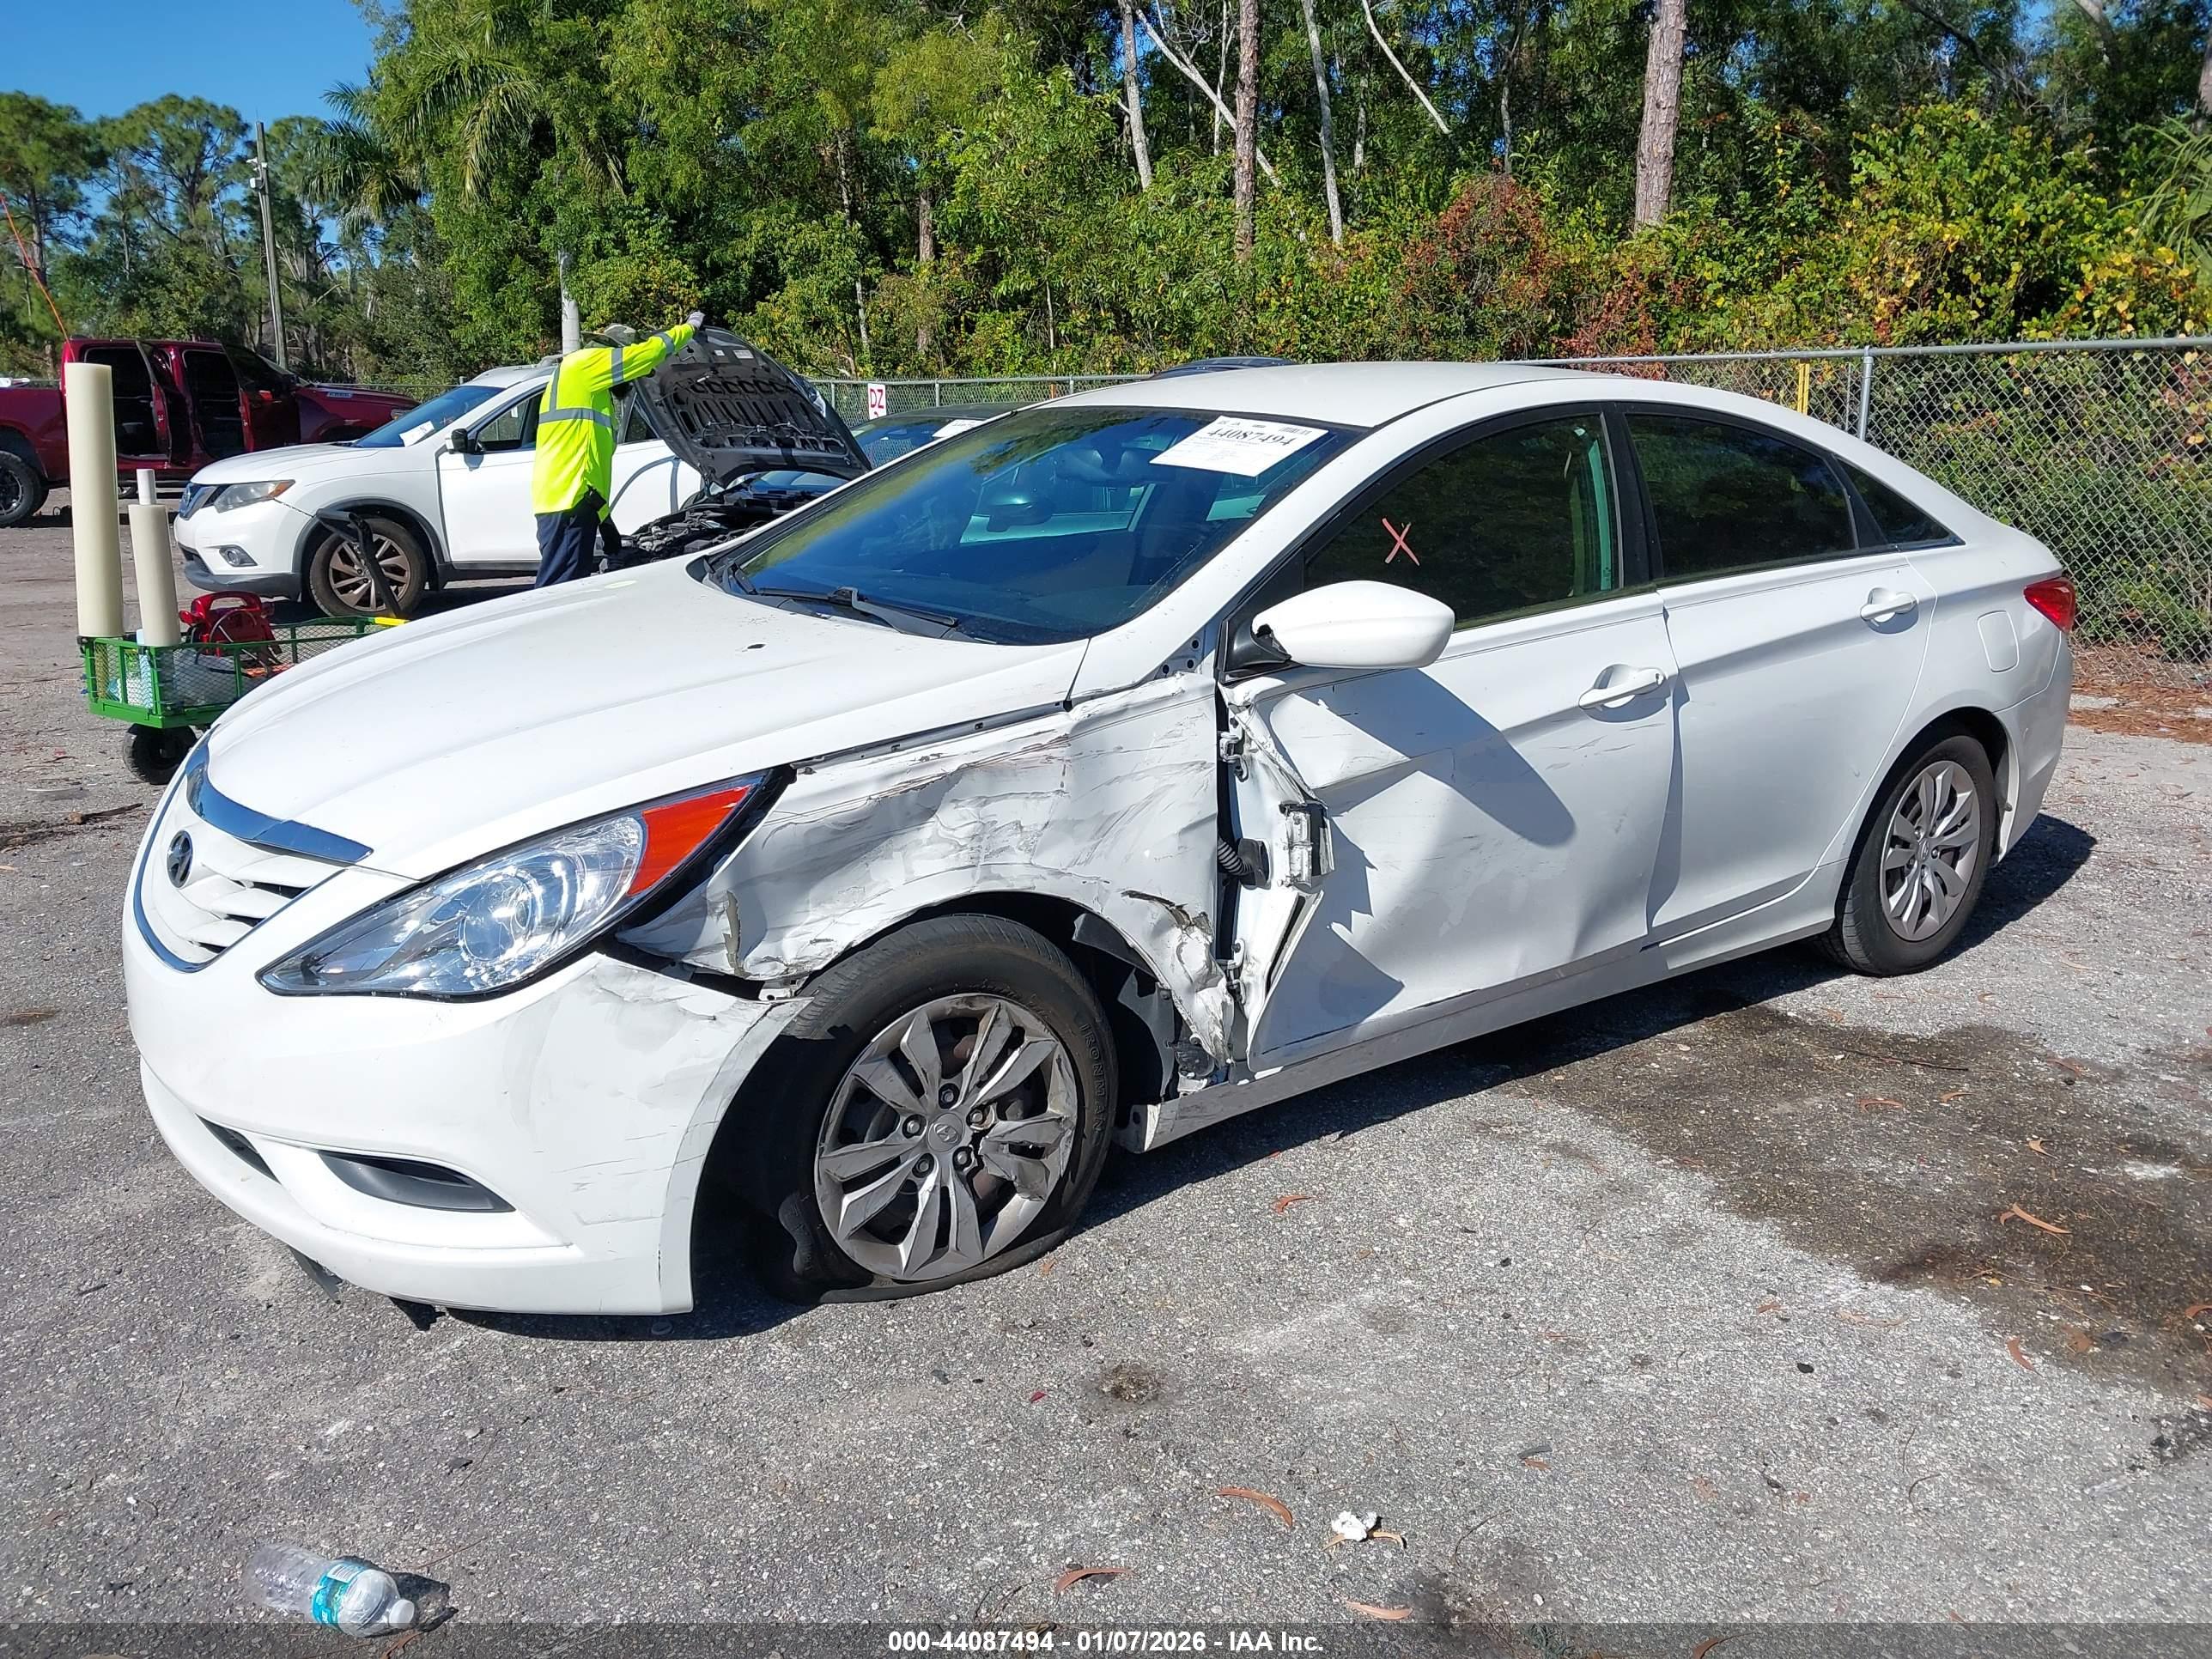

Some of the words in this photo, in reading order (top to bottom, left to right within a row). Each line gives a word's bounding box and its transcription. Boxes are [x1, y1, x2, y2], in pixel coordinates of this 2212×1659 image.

[869, 388, 884, 409] DZ
[1207, 428, 1296, 446] 44087494
[1079, 1023, 1106, 1133] IRONMAN
